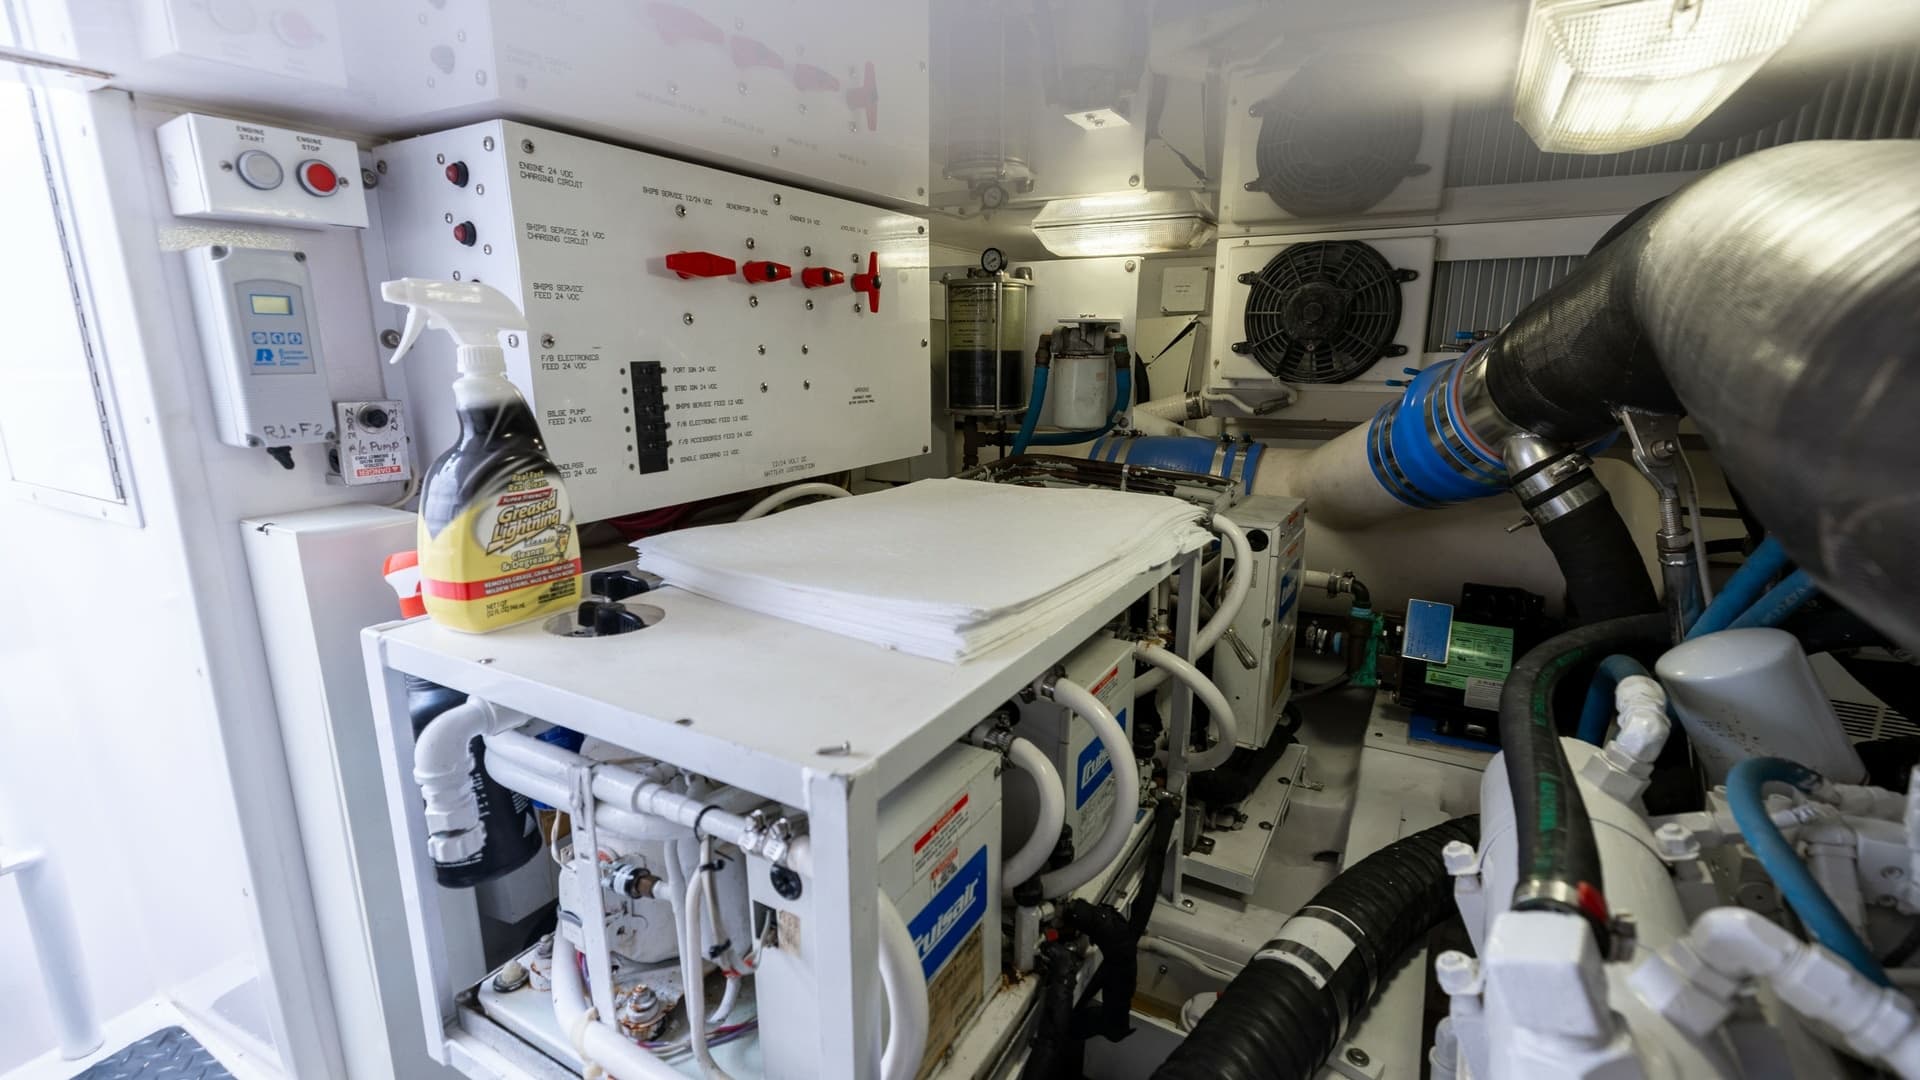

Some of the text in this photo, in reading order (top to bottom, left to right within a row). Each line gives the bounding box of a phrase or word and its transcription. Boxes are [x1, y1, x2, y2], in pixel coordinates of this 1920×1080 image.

[236, 125, 264, 136] ENGINE
[239, 134, 264, 144] START
[296, 135, 322, 146] ENGINE
[301, 143, 321, 152] STOP
[519, 161, 573, 178] ENGINE 24 VDC
[519, 170, 583, 189] CHARGING CIRCUIT
[642, 186, 659, 195] SHIPS
[661, 189, 683, 200] SERVICE
[526, 223, 547, 232] SHIPS
[550, 226, 578, 236] SERVICE
[527, 232, 588, 246] CHARGING CIRCUIT
[532, 283, 584, 293] SHIPS SERVICE
[534, 292, 580, 301] FEED 24 VDC
[540, 354, 600, 362] F/B ELECTRONICS
[562, 362, 571, 370] 24
[575, 362, 587, 370] VDC
[547, 408, 586, 418] BILGE PUMP
[548, 417, 565, 426] FEED
[580, 415, 592, 423] VDC
[574, 469, 582, 477] 24
[585, 467, 597, 475] VDC
[498, 489, 558, 525] Greased
[491, 509, 561, 545] Lightning
[511, 547, 545, 561] Cleaner
[501, 554, 555, 572] & Degreaser
